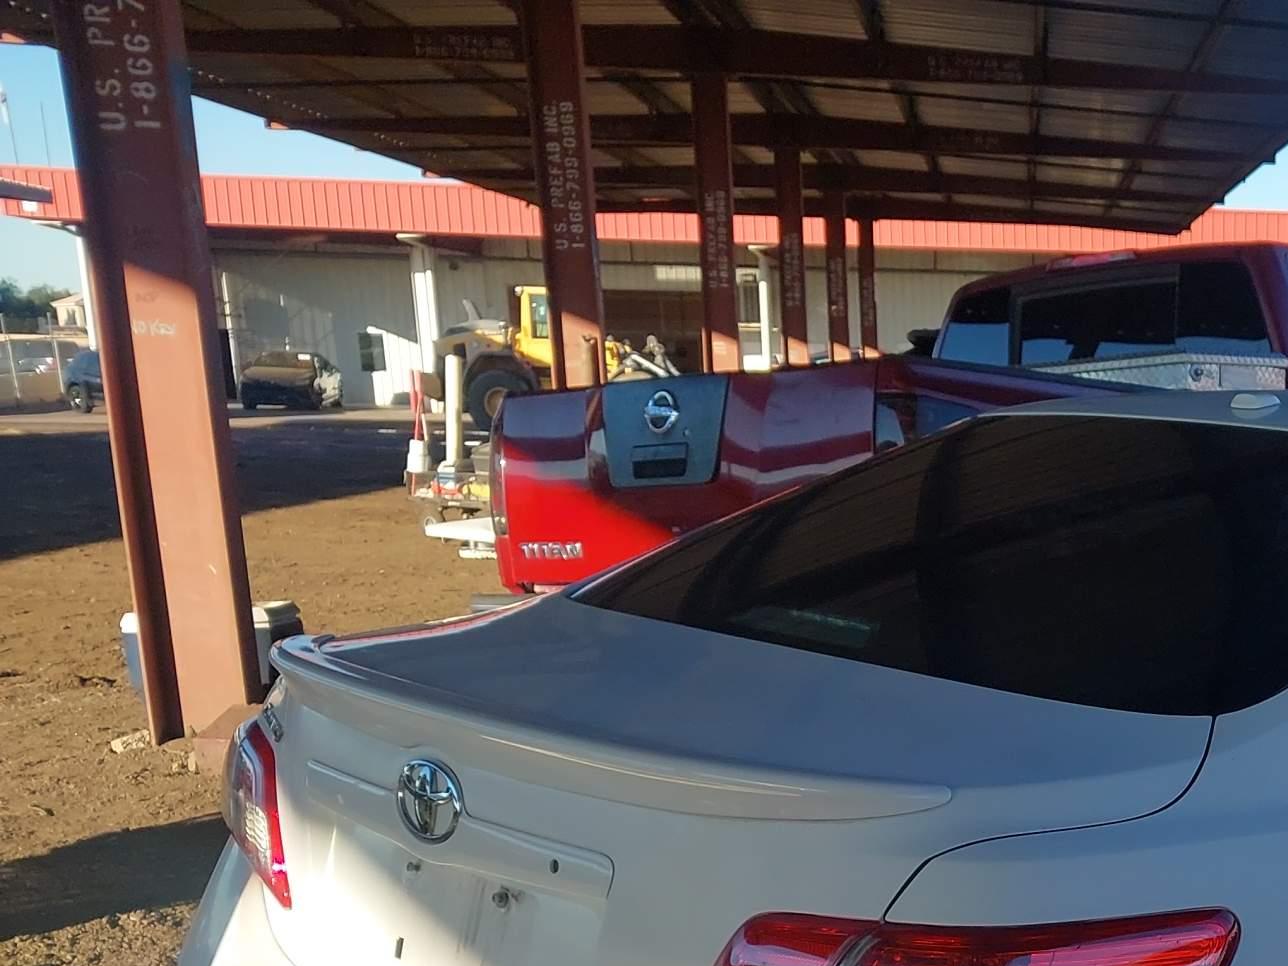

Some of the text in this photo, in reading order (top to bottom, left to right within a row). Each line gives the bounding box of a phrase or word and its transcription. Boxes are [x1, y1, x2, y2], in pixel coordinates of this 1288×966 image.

[95, 68, 127, 130] U.S.
[545, 140, 565, 208] PREFAB
[519, 542, 583, 560] TITAN
